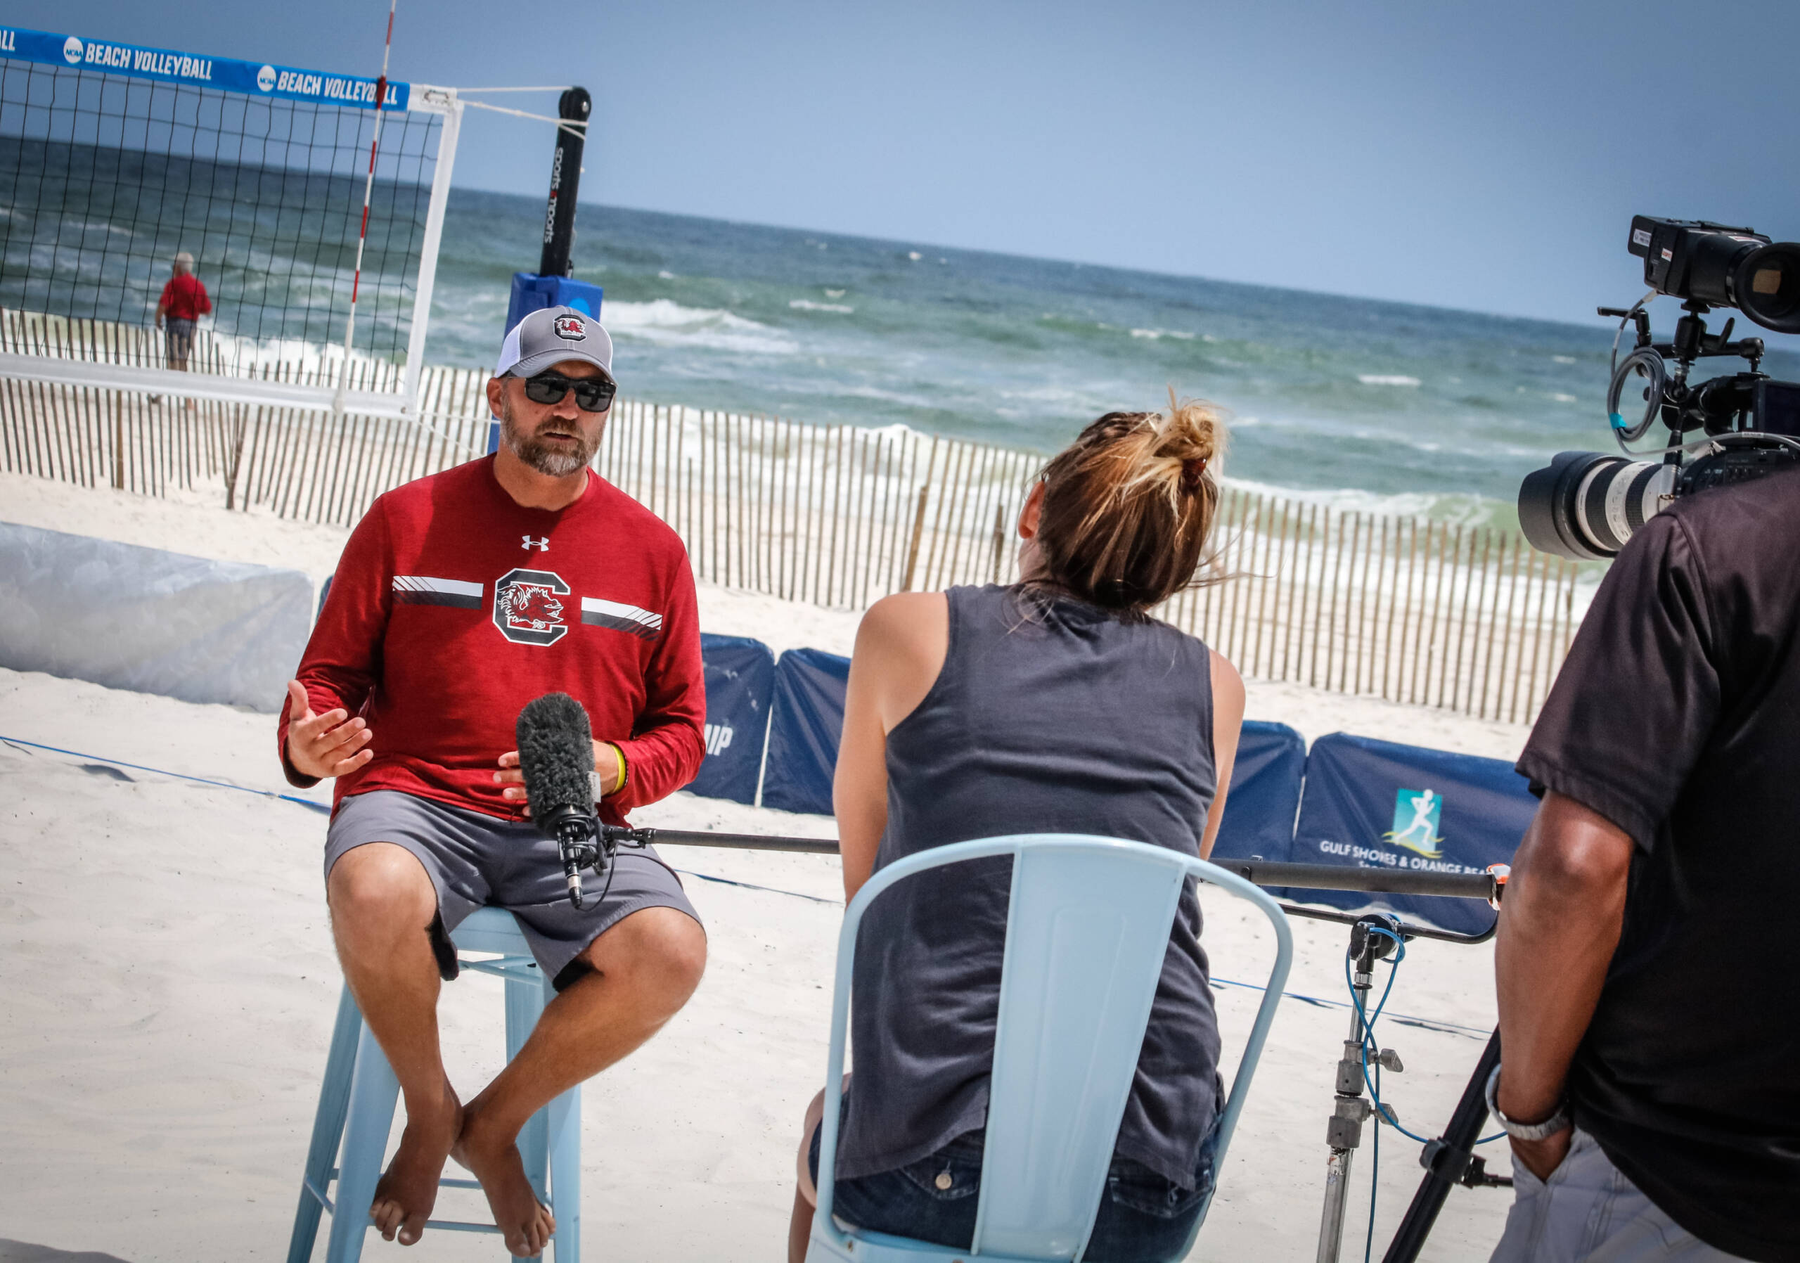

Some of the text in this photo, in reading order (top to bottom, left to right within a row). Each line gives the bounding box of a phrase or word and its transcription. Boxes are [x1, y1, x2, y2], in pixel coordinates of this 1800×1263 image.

[0, 29, 16, 51] LL
[66, 48, 83, 57] NCAA
[85, 43, 212, 80] BEACH VOLLEYBALL
[277, 71, 322, 95] BEACH
[324, 78, 397, 105] VOLLEYBLL
[551, 147, 563, 190] sports
[1320, 840, 1351, 856] GULF
[1398, 856, 1408, 868] &
[1410, 858, 1462, 874] ORANGE
